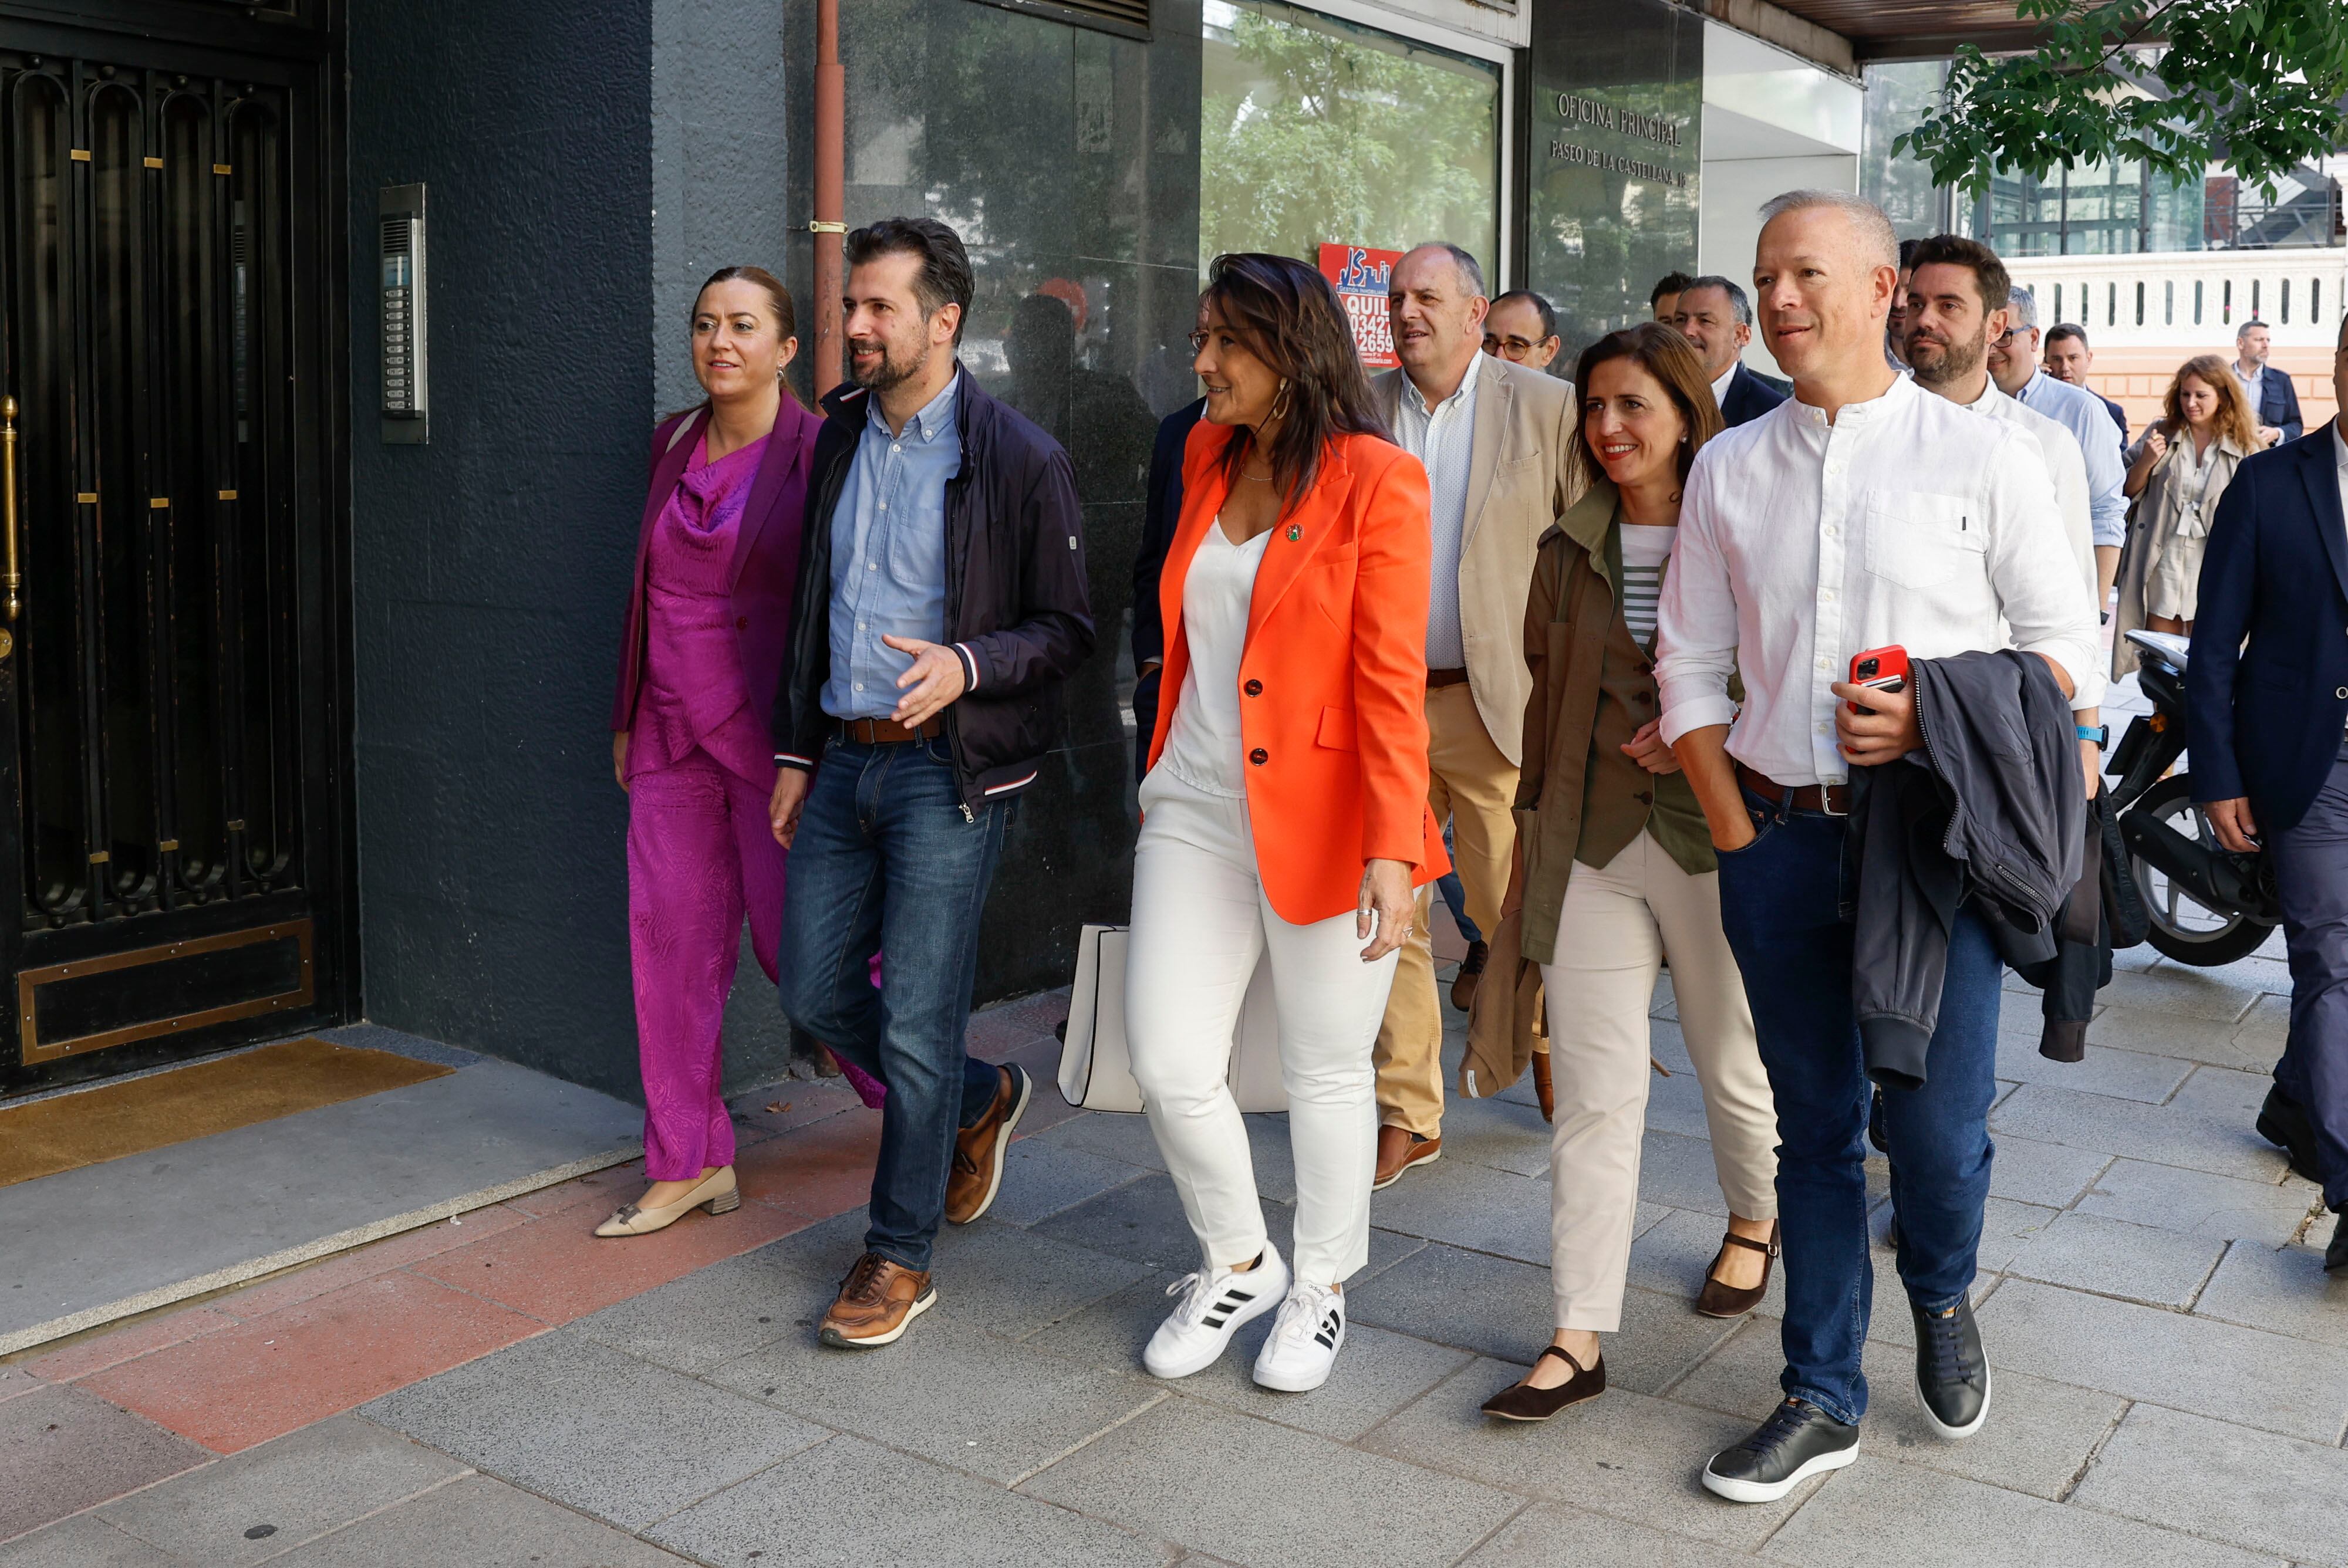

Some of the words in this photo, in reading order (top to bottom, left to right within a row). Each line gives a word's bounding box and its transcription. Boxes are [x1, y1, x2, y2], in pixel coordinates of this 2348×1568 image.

[1558, 93, 1614, 129] OFICINA
[1620, 109, 1681, 147] PRINCIPAL
[1551, 140, 1583, 163] PASEO
[1587, 148, 1599, 167] DE
[1603, 152, 1614, 171] LA
[1618, 157, 1674, 185] CASTELLANA
[1347, 295, 1390, 316] QUIL
[1348, 314, 1391, 335] 03427
[1308, 1283, 1325, 1297] adidas
